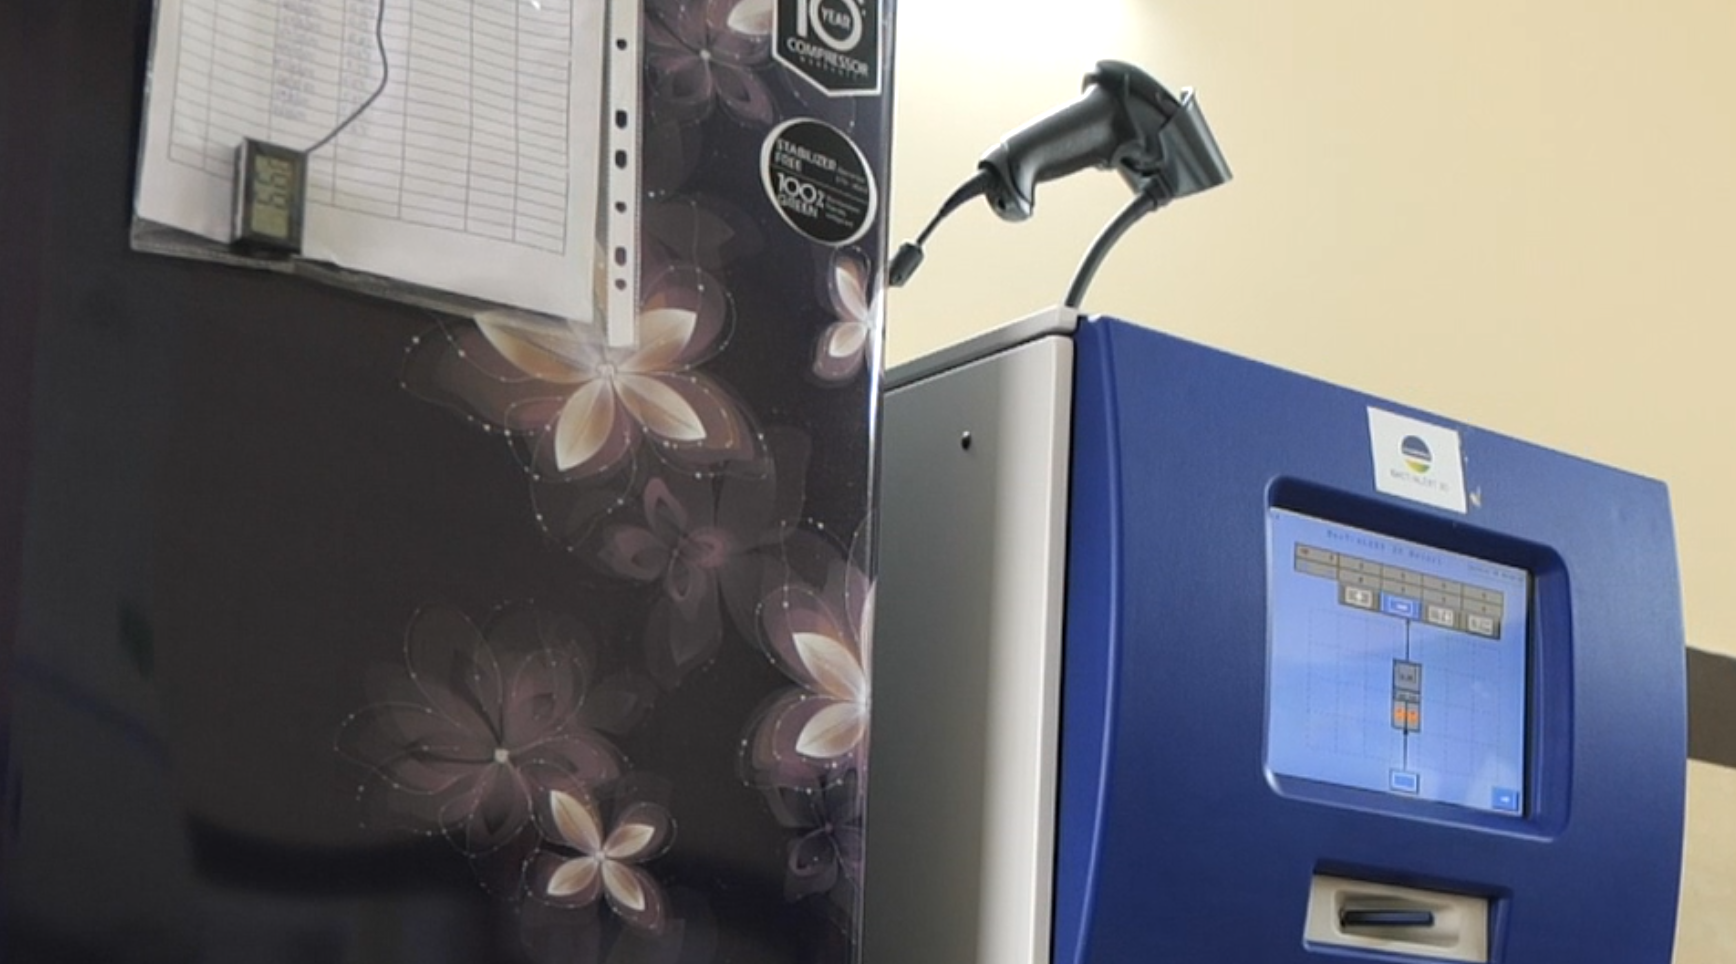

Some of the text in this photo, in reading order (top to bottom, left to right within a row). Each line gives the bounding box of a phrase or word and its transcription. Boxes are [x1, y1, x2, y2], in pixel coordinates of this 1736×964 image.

[822, 6, 851, 30] YEAR
[786, 37, 869, 77] COMPRESSOR
[776, 139, 837, 171] STABILIZER
